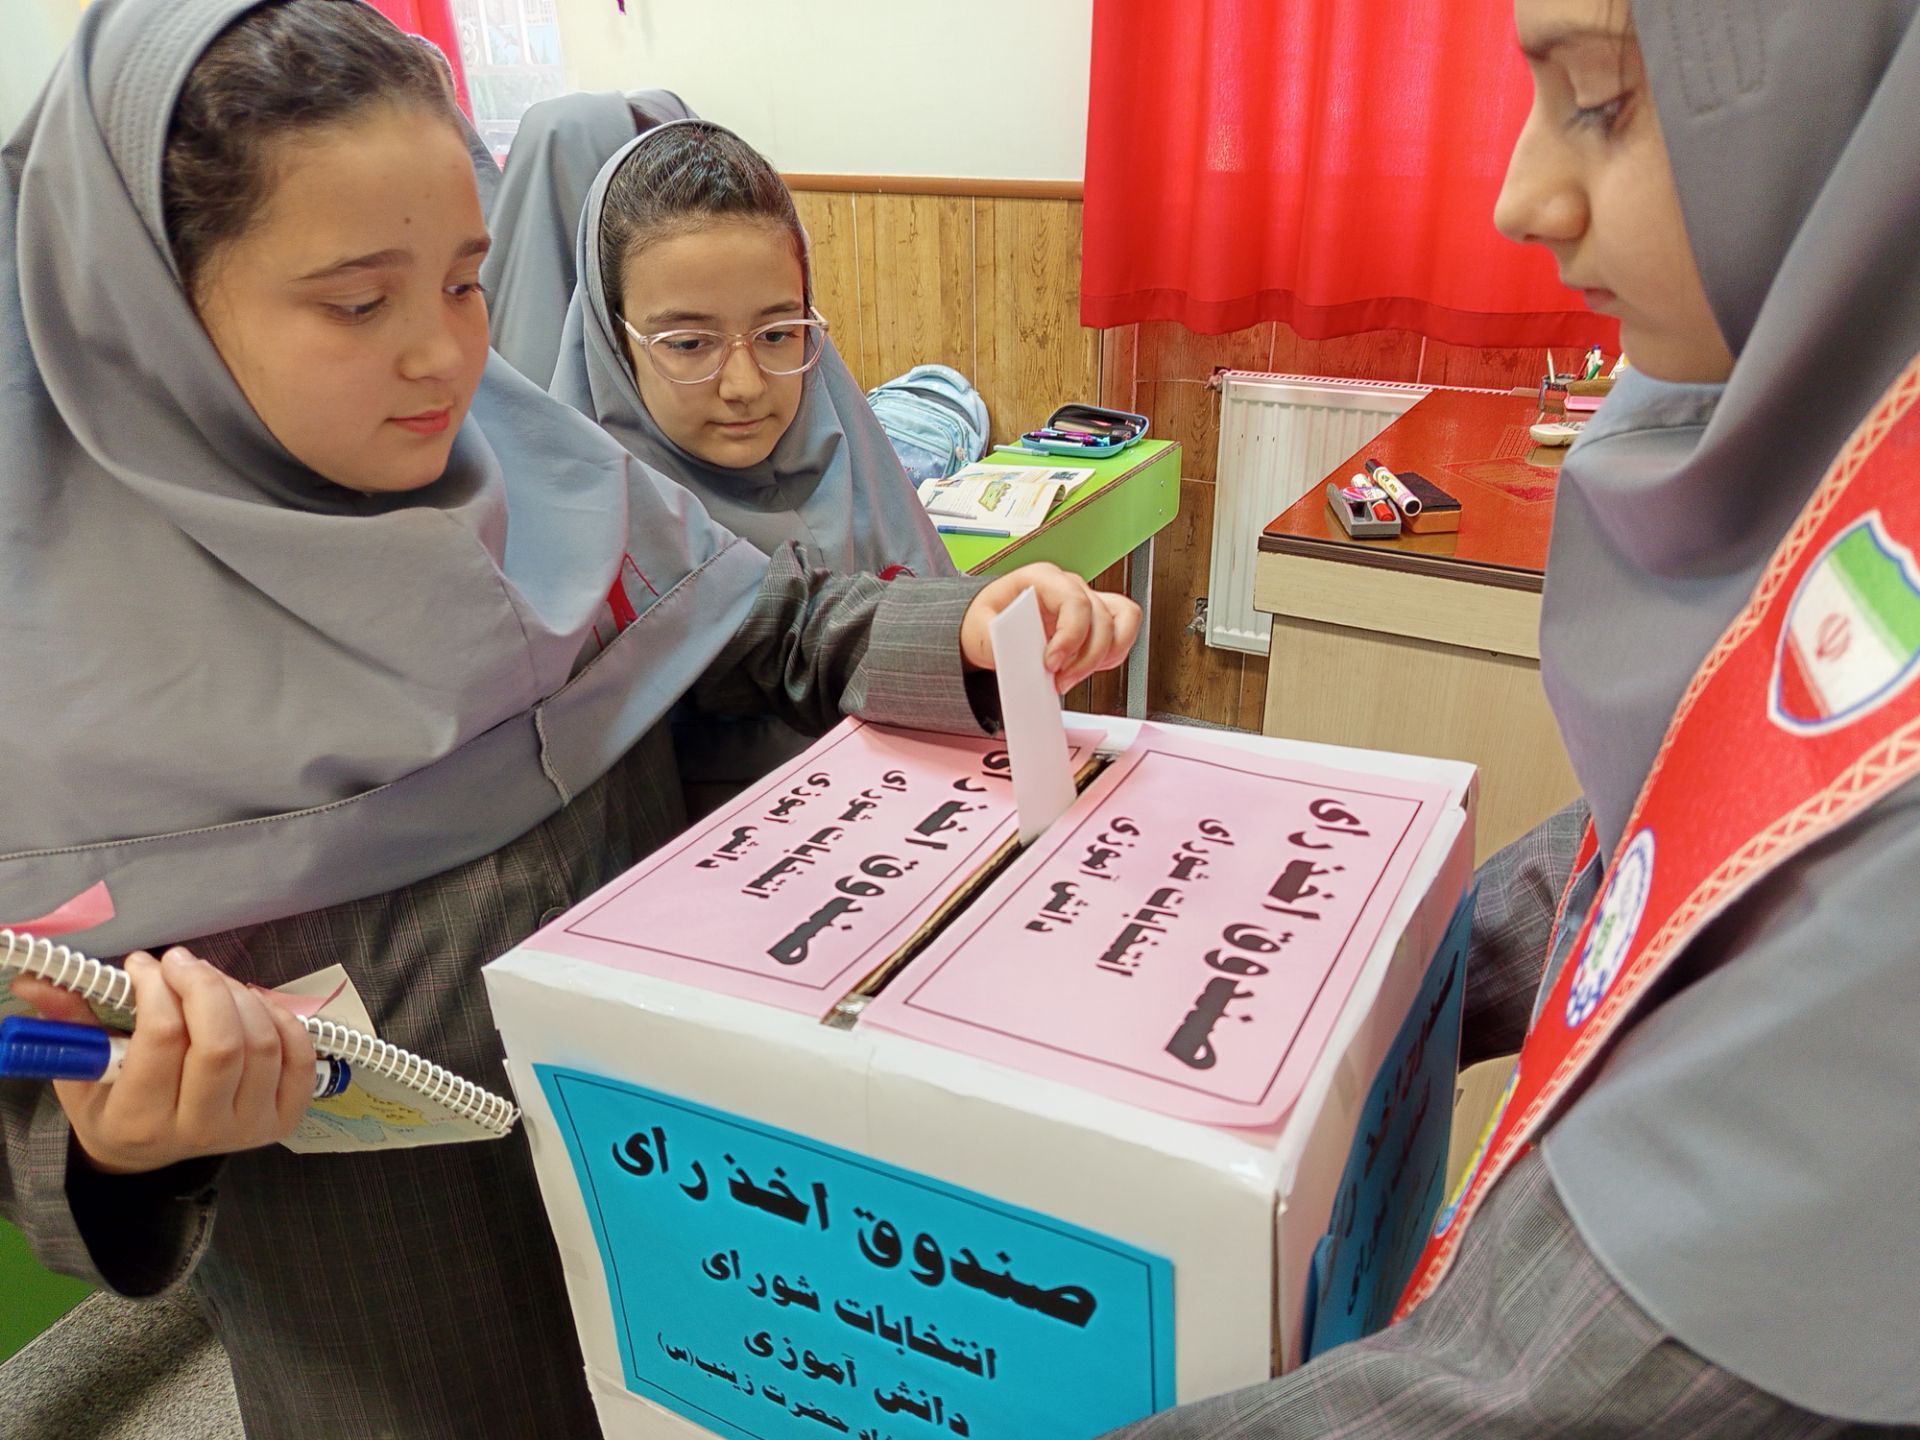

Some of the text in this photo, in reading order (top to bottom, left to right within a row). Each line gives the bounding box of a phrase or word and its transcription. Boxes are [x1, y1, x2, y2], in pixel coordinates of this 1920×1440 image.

[695, 772, 831, 869] دانش آموزی
[741, 769, 908, 899] انتخابات شورای
[766, 854, 919, 966] صندوق
[905, 799, 988, 851] اخذ
[1024, 816, 1140, 933] دانش آموزی
[1096, 818, 1235, 977] انتخابات شورای
[1164, 798, 1371, 1071] صندوق اخذ رای
[612, 1127, 1097, 1328] صندوق اخذ رای
[702, 1250, 997, 1379] انتخابات شورای
[744, 1331, 969, 1437] دانش آموزی
[761, 1384, 850, 1433] حضرت
